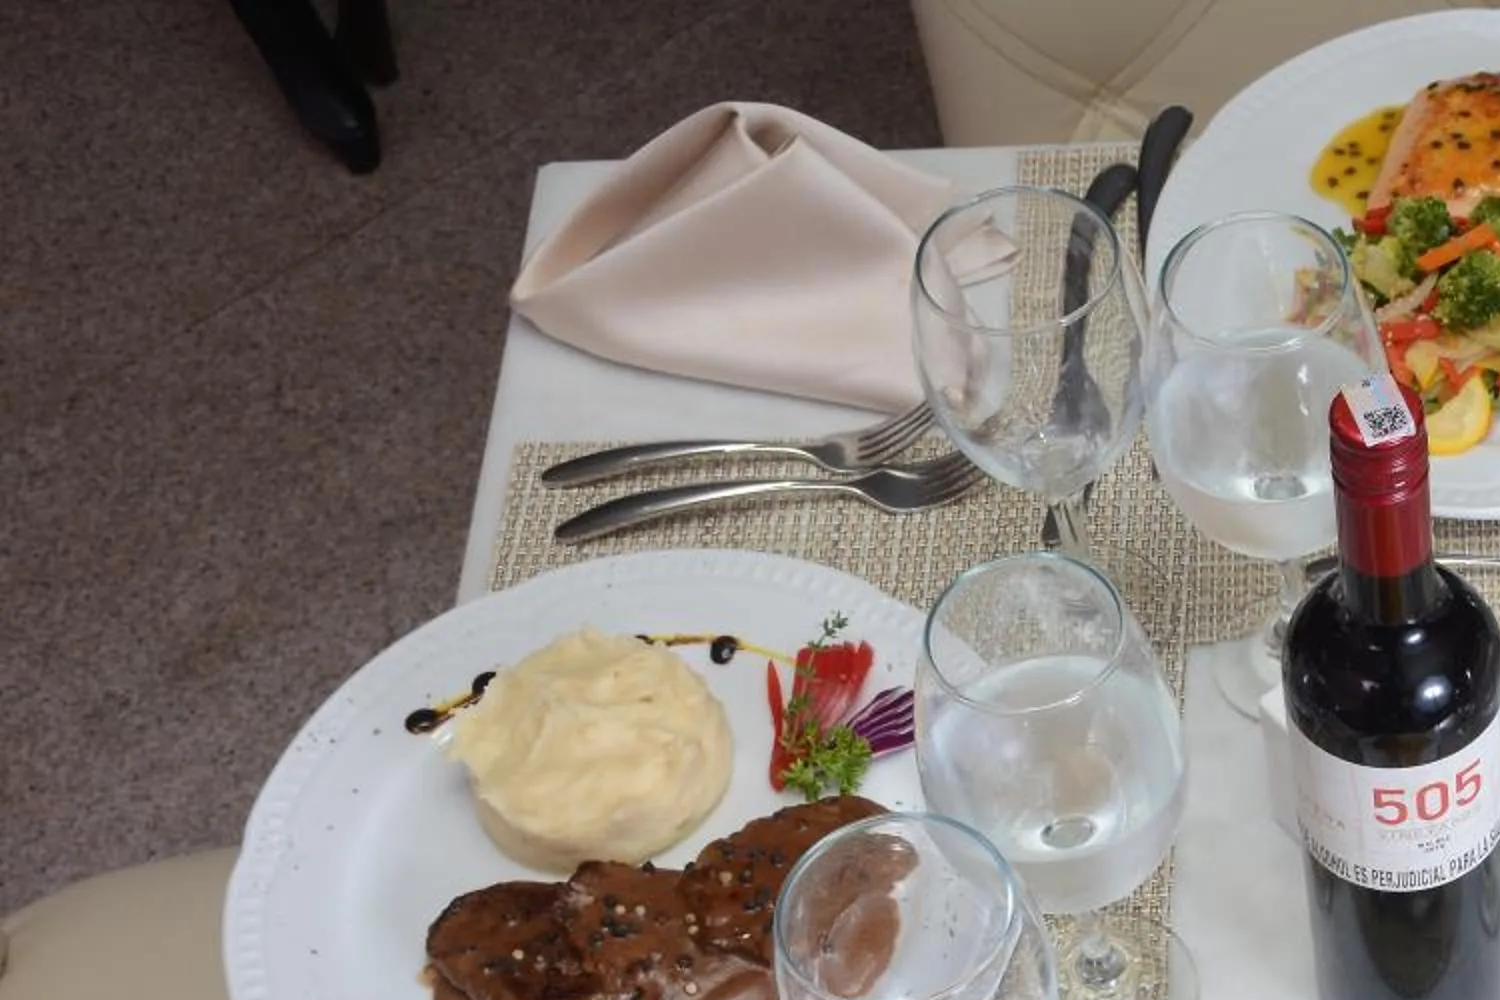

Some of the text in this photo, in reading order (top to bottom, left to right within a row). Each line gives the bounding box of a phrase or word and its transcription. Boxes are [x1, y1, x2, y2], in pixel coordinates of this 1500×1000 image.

[1372, 758, 1483, 826] 505
[1353, 863, 1369, 884] ES
[1371, 867, 1446, 889] PERJUDICIAL
[1449, 847, 1477, 877] PARA
